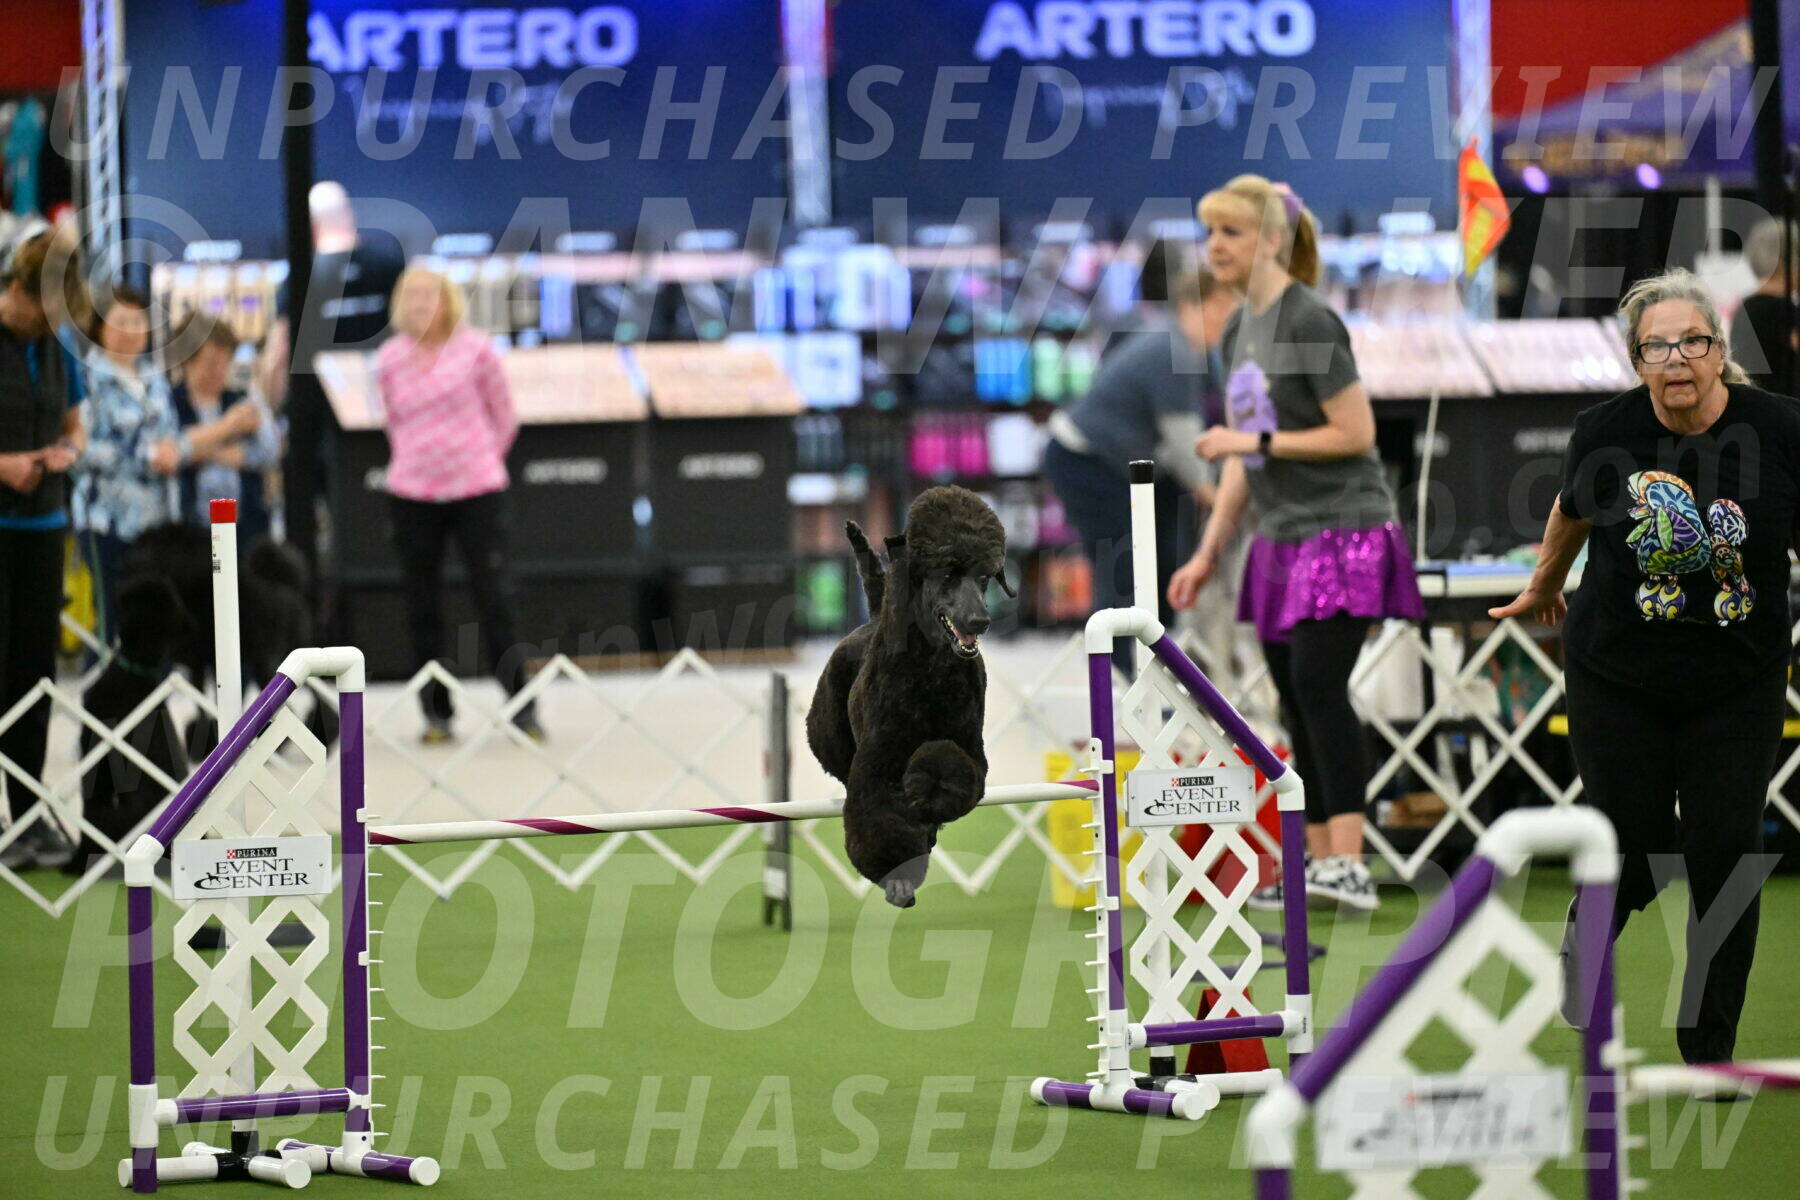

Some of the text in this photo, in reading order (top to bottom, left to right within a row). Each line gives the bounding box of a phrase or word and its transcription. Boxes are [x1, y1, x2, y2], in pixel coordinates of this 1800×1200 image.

[308, 6, 638, 71] ARTERO
[975, 0, 1316, 60] ARTERO
[1180, 777, 1214, 786] PURINA
[1162, 787, 1228, 801] EVENT
[1143, 799, 1241, 816] CENTER
[237, 848, 277, 858] PURINA
[215, 858, 294, 875] EVENT
[193, 872, 310, 890] CENTER
